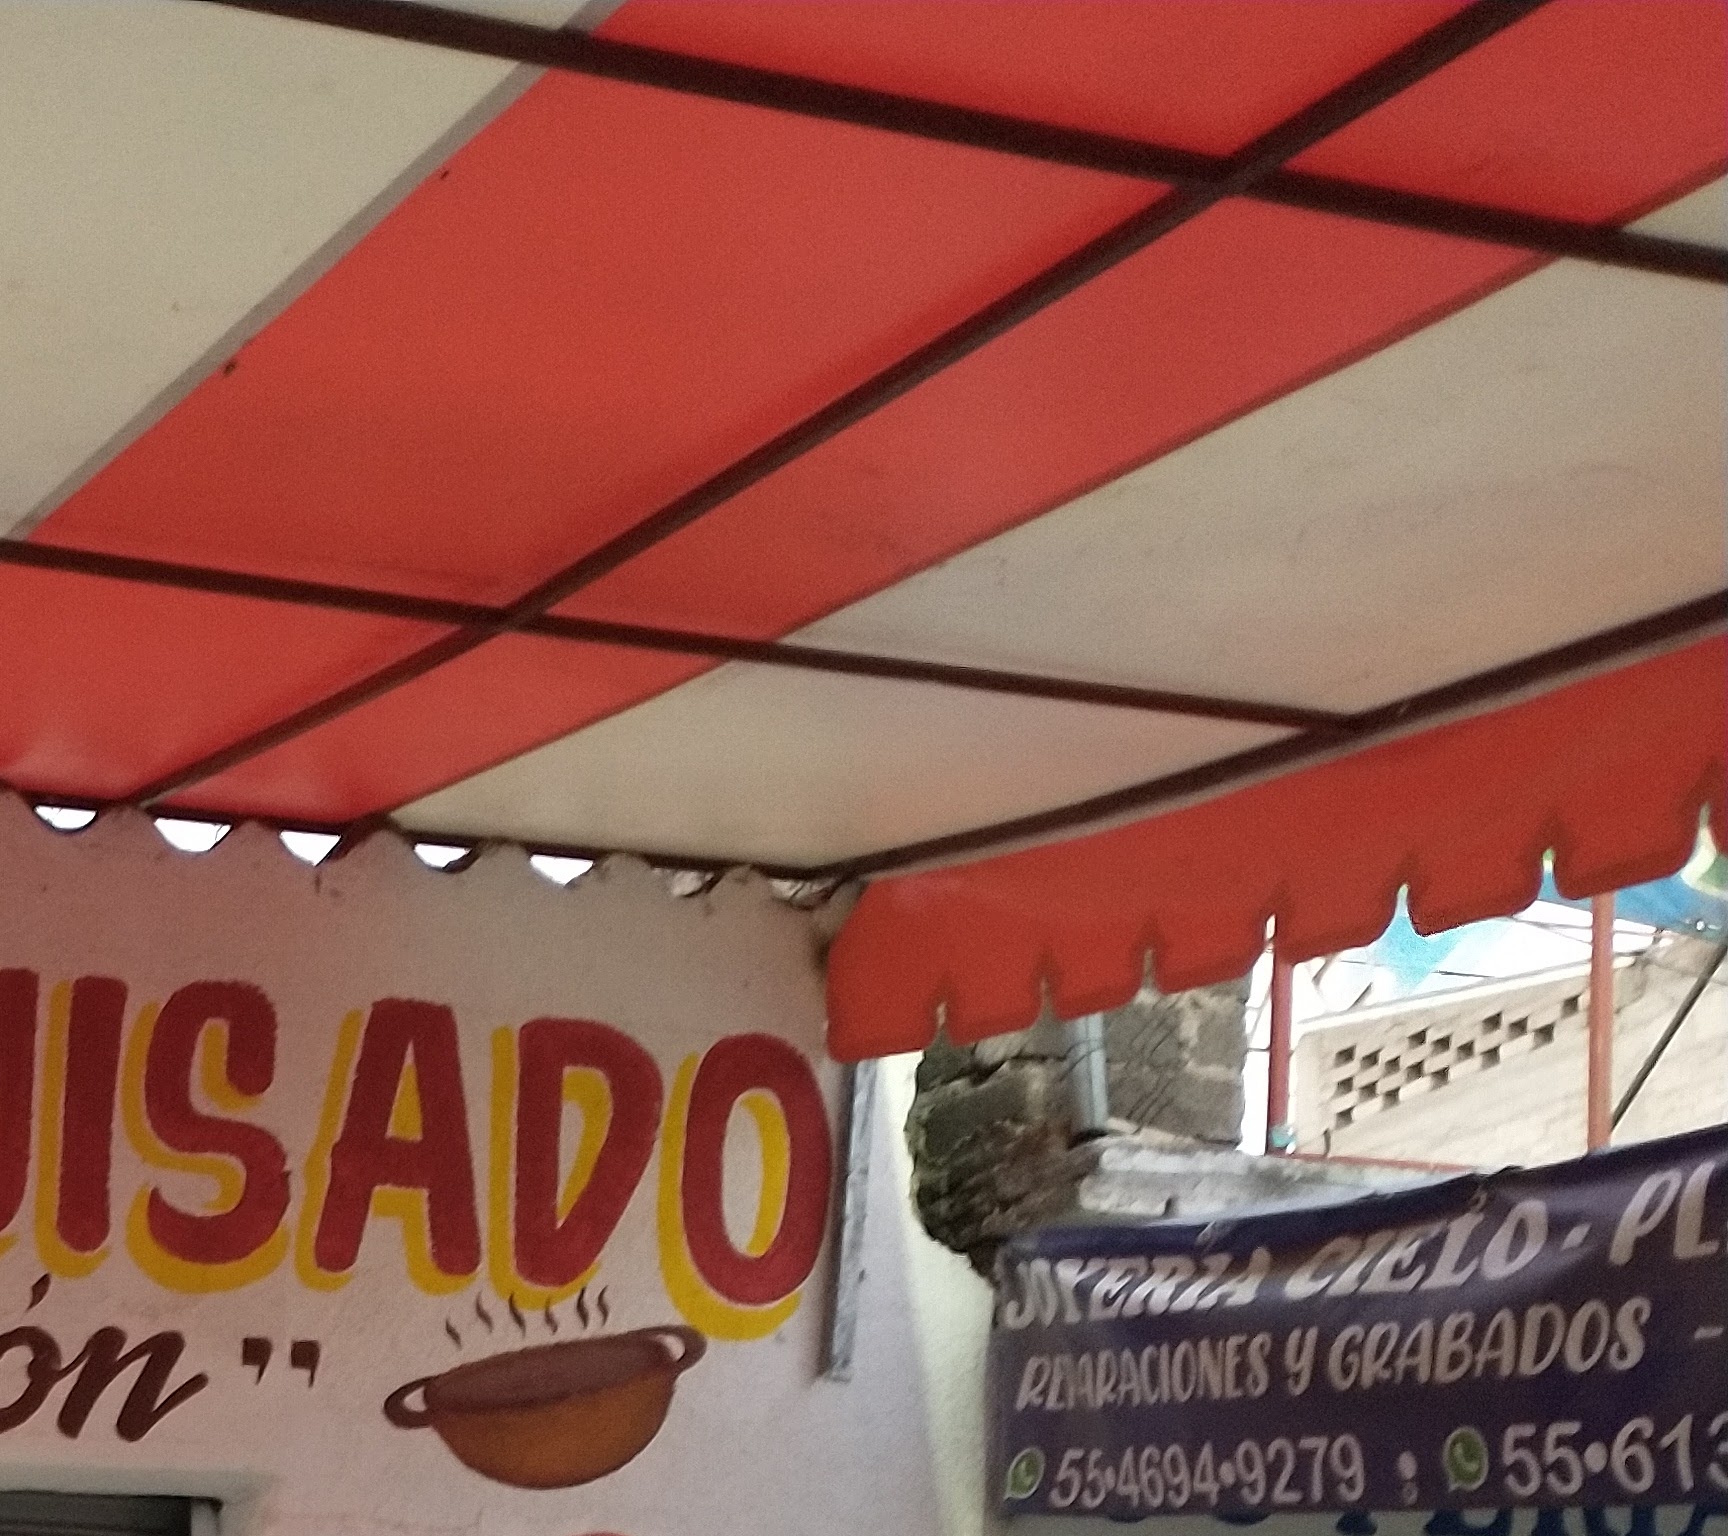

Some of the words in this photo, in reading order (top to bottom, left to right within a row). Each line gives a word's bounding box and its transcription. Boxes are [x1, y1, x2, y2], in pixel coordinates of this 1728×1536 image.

[1283, 1200, 1549, 1300] CIELO
[1608, 1160, 1728, 1267] PL
[1015, 1331, 1272, 1412] REARACIONES
[1328, 1296, 1652, 1392] GRABADOS
